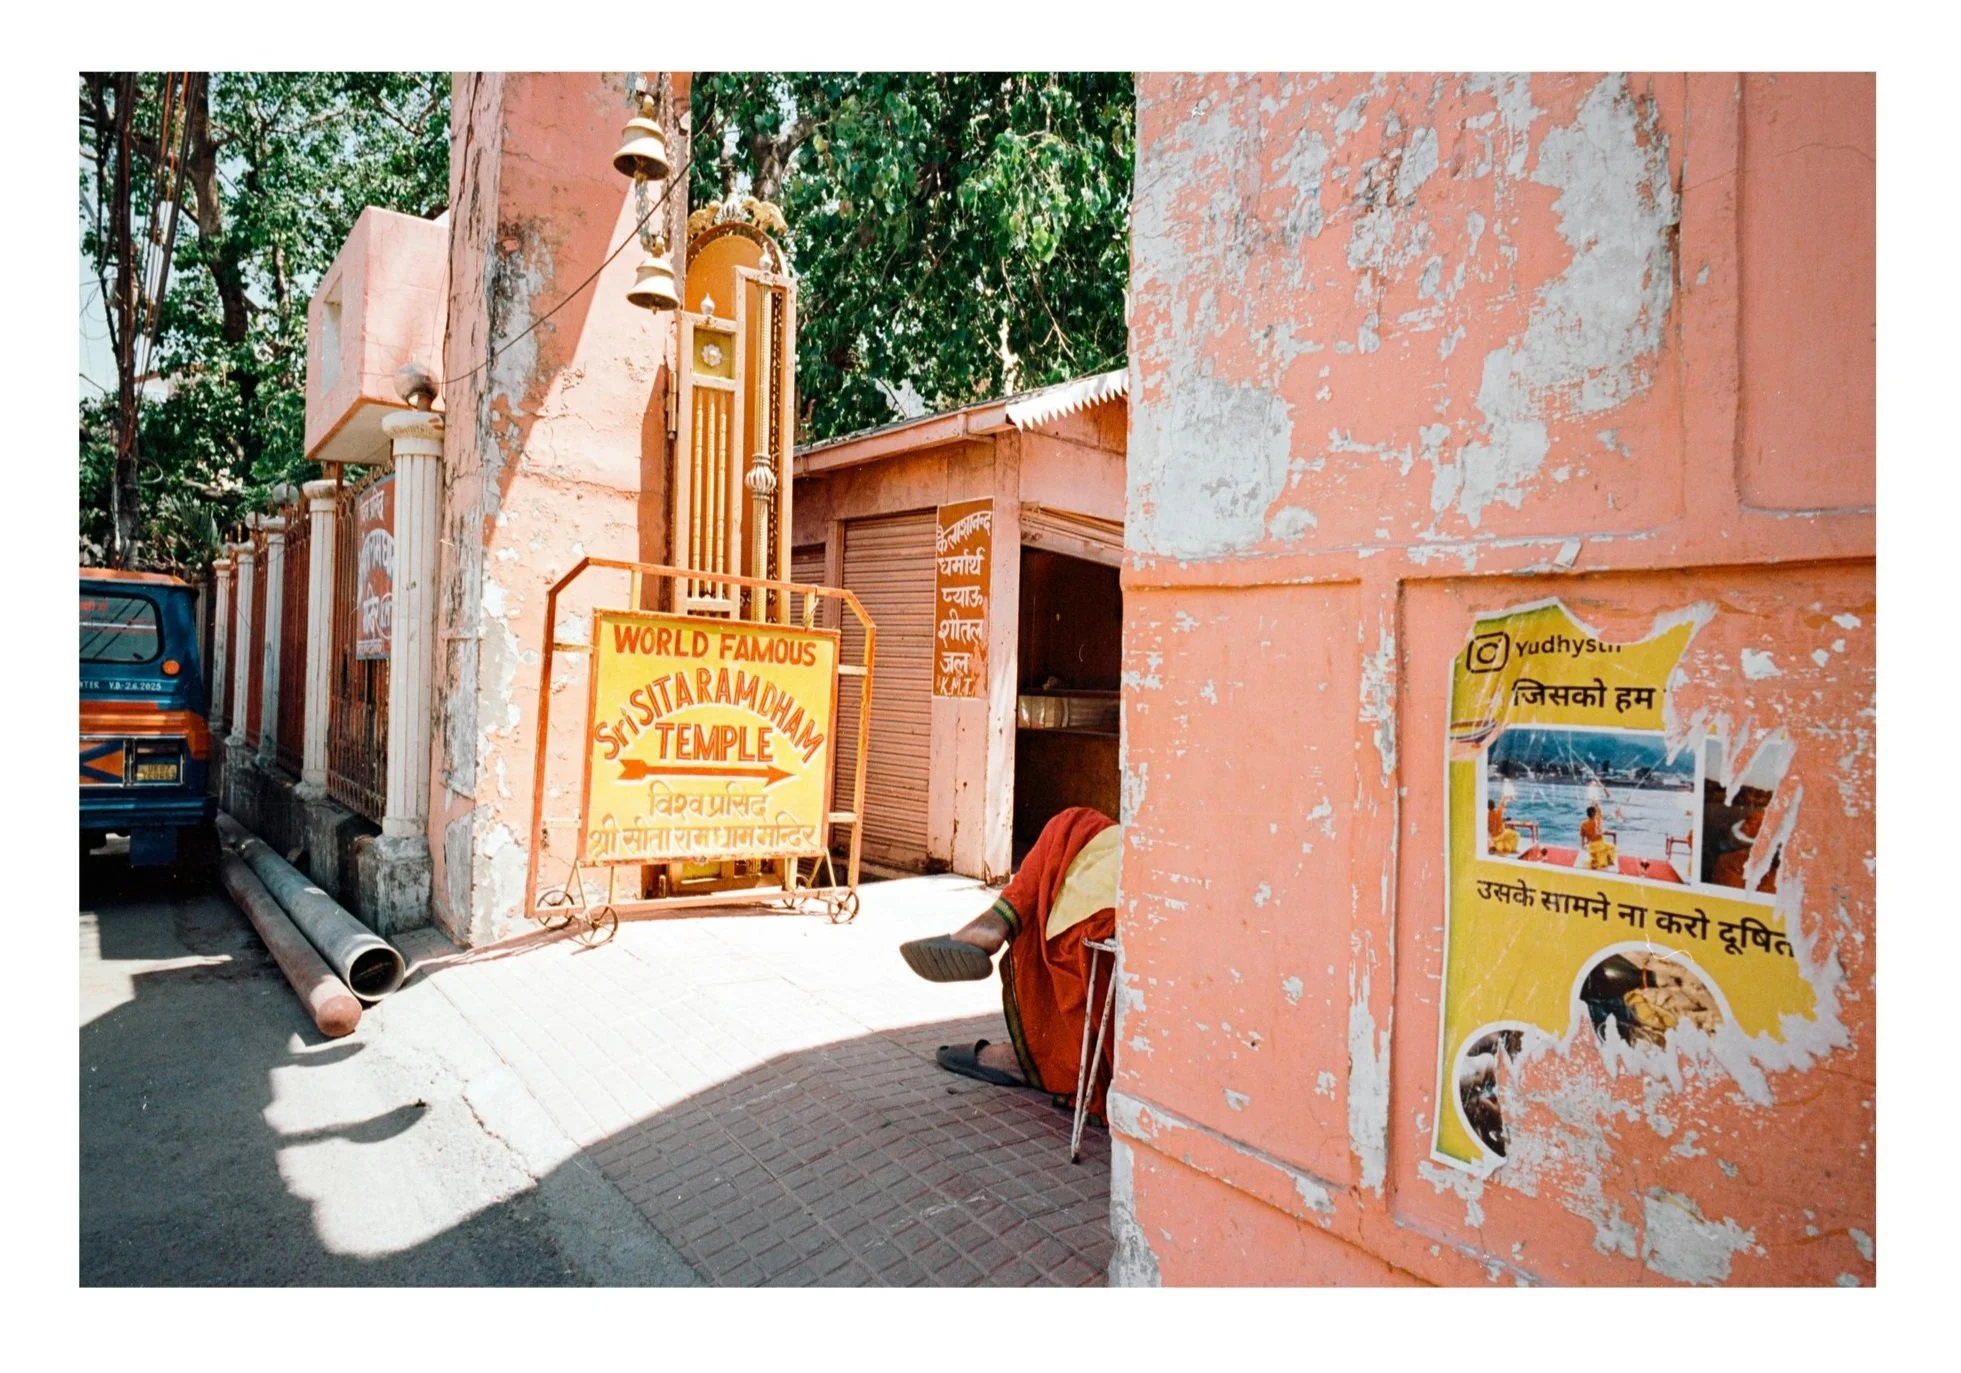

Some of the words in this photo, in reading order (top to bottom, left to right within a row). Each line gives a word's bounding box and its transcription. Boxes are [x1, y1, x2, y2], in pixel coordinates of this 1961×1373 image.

[613, 624, 709, 659] WORLD
[719, 633, 817, 668] FAMOUS
[1512, 677, 1608, 708] जिसको
[1615, 687, 1656, 713] हम
[594, 707, 641, 761] Sri
[655, 722, 774, 763] TEMPLE
[1477, 878, 1535, 906] उसके
[1540, 891, 1610, 921] सामने
[1617, 903, 1648, 928] ना
[1654, 907, 1710, 940] करो
